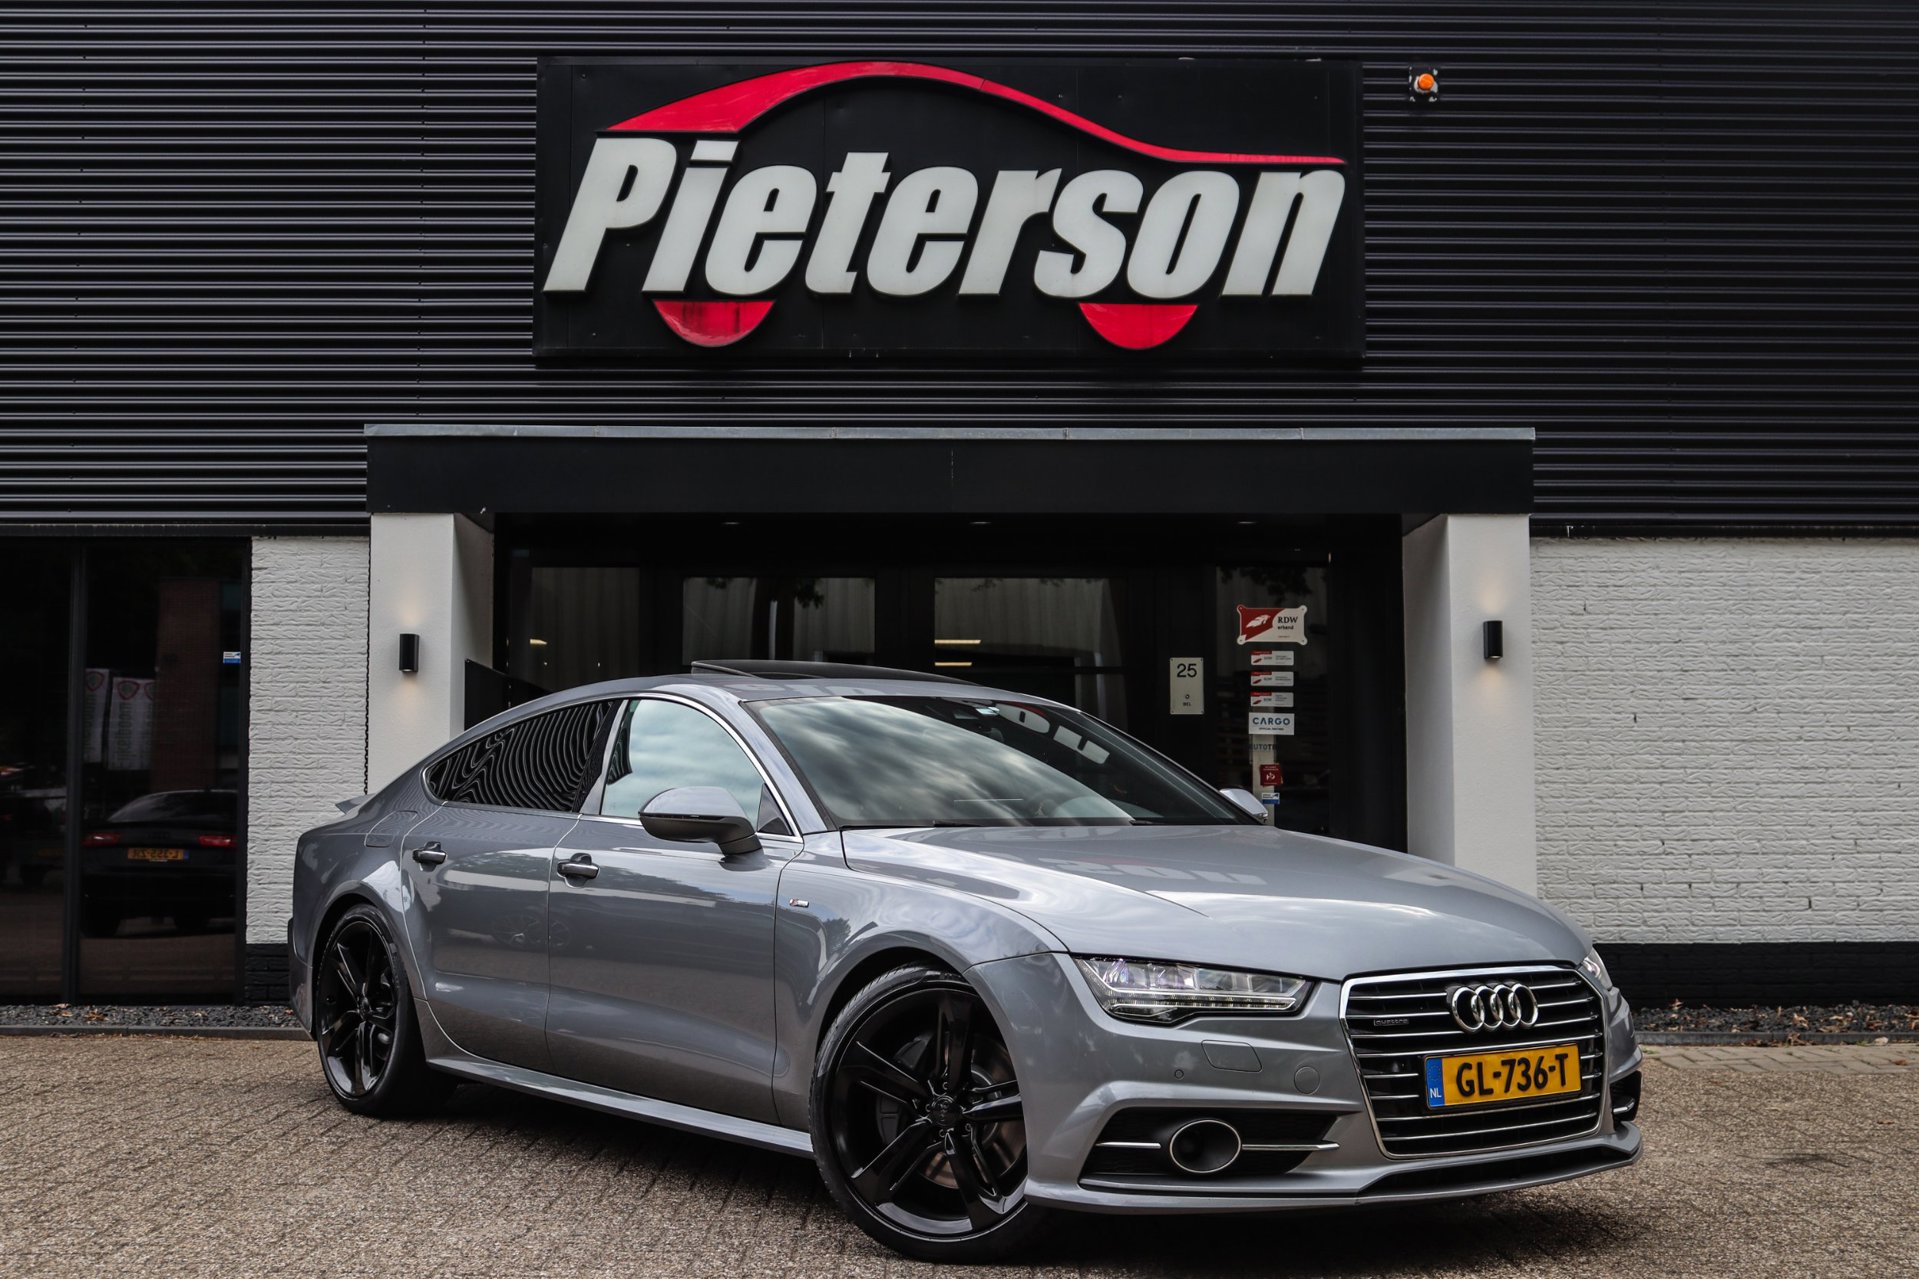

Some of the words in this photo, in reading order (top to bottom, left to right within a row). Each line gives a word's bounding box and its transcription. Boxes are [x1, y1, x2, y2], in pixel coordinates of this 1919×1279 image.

[543, 137, 1346, 299] Pieterson
[1277, 616, 1298, 624] RDW
[1177, 663, 1197, 678] 25
[1252, 717, 1291, 726] CARGO
[1430, 1087, 1442, 1098] NL
[1456, 1053, 1569, 1098] GL-736-T
